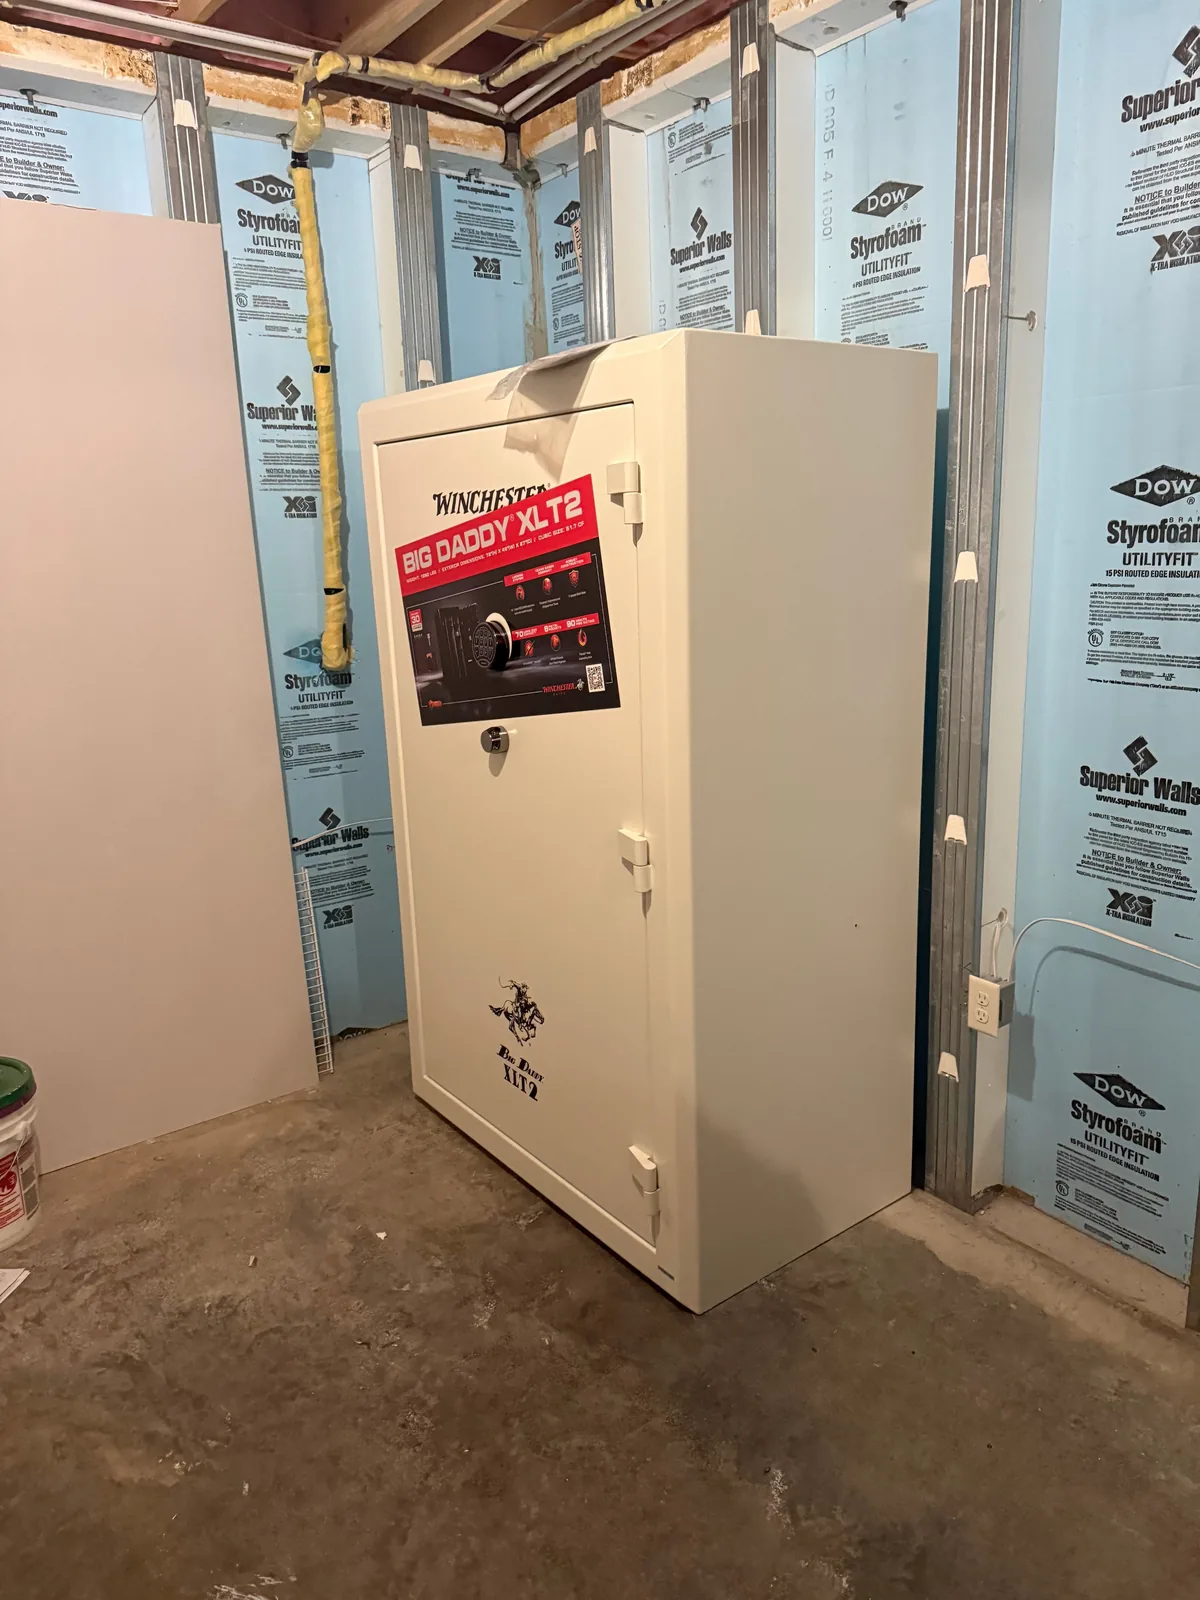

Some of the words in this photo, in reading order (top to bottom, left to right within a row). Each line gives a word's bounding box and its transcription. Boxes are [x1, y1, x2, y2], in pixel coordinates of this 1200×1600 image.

[1121, 78, 1200, 123] Superior
[252, 180, 294, 198] DOW
[866, 186, 909, 212] DOW
[1134, 189, 1164, 204] NOTICE
[1164, 188, 1172, 196] to
[1150, 203, 1179, 215] guidelines
[237, 208, 301, 234] Styrofoa
[252, 235, 303, 251] UTILITYFIT
[555, 240, 575, 259] Styro
[670, 241, 705, 266] Superior
[707, 230, 732, 254] Walls
[850, 223, 922, 260] Styrofoam
[861, 252, 911, 276] UTILITYFIT
[892, 266, 921, 280] INSULATION
[247, 403, 298, 422] Superior
[1134, 478, 1198, 496] DOW
[402, 545, 433, 575] BIG
[436, 515, 510, 564] DADDY
[538, 532, 552, 540] CUBIC
[1122, 552, 1193, 567] UTILITYFIT
[1105, 569, 1112, 577] 15
[1113, 569, 1124, 577] PSI
[1150, 570, 1168, 578] EDGE
[411, 615, 420, 624] 30
[285, 672, 352, 691] Styrofoam
[298, 690, 344, 703] UTILITYFIT
[1080, 765, 1149, 796] Superior
[1153, 777, 1200, 805] Walls
[1095, 794, 1187, 816] www.superiorwalls.com
[341, 826, 370, 843] Walls
[1092, 849, 1117, 860] NOTICE
[1126, 856, 1149, 867] Builder
[1150, 861, 1155, 869] &
[1157, 863, 1182, 875] Owner:
[1151, 868, 1174, 879] Superior
[496, 1044, 516, 1065] BIG
[503, 1063, 538, 1102] XLT2
[1094, 1075, 1148, 1107] DOW
[1071, 1099, 1161, 1154] Styrofoam
[1084, 1130, 1146, 1165] UTILITYFIT
[1076, 1140, 1086, 1149] PSI
[1086, 1144, 1108, 1159] ROUTED
[1108, 1155, 1123, 1166] EDGE
[1124, 1161, 1160, 1182] INSULATION
